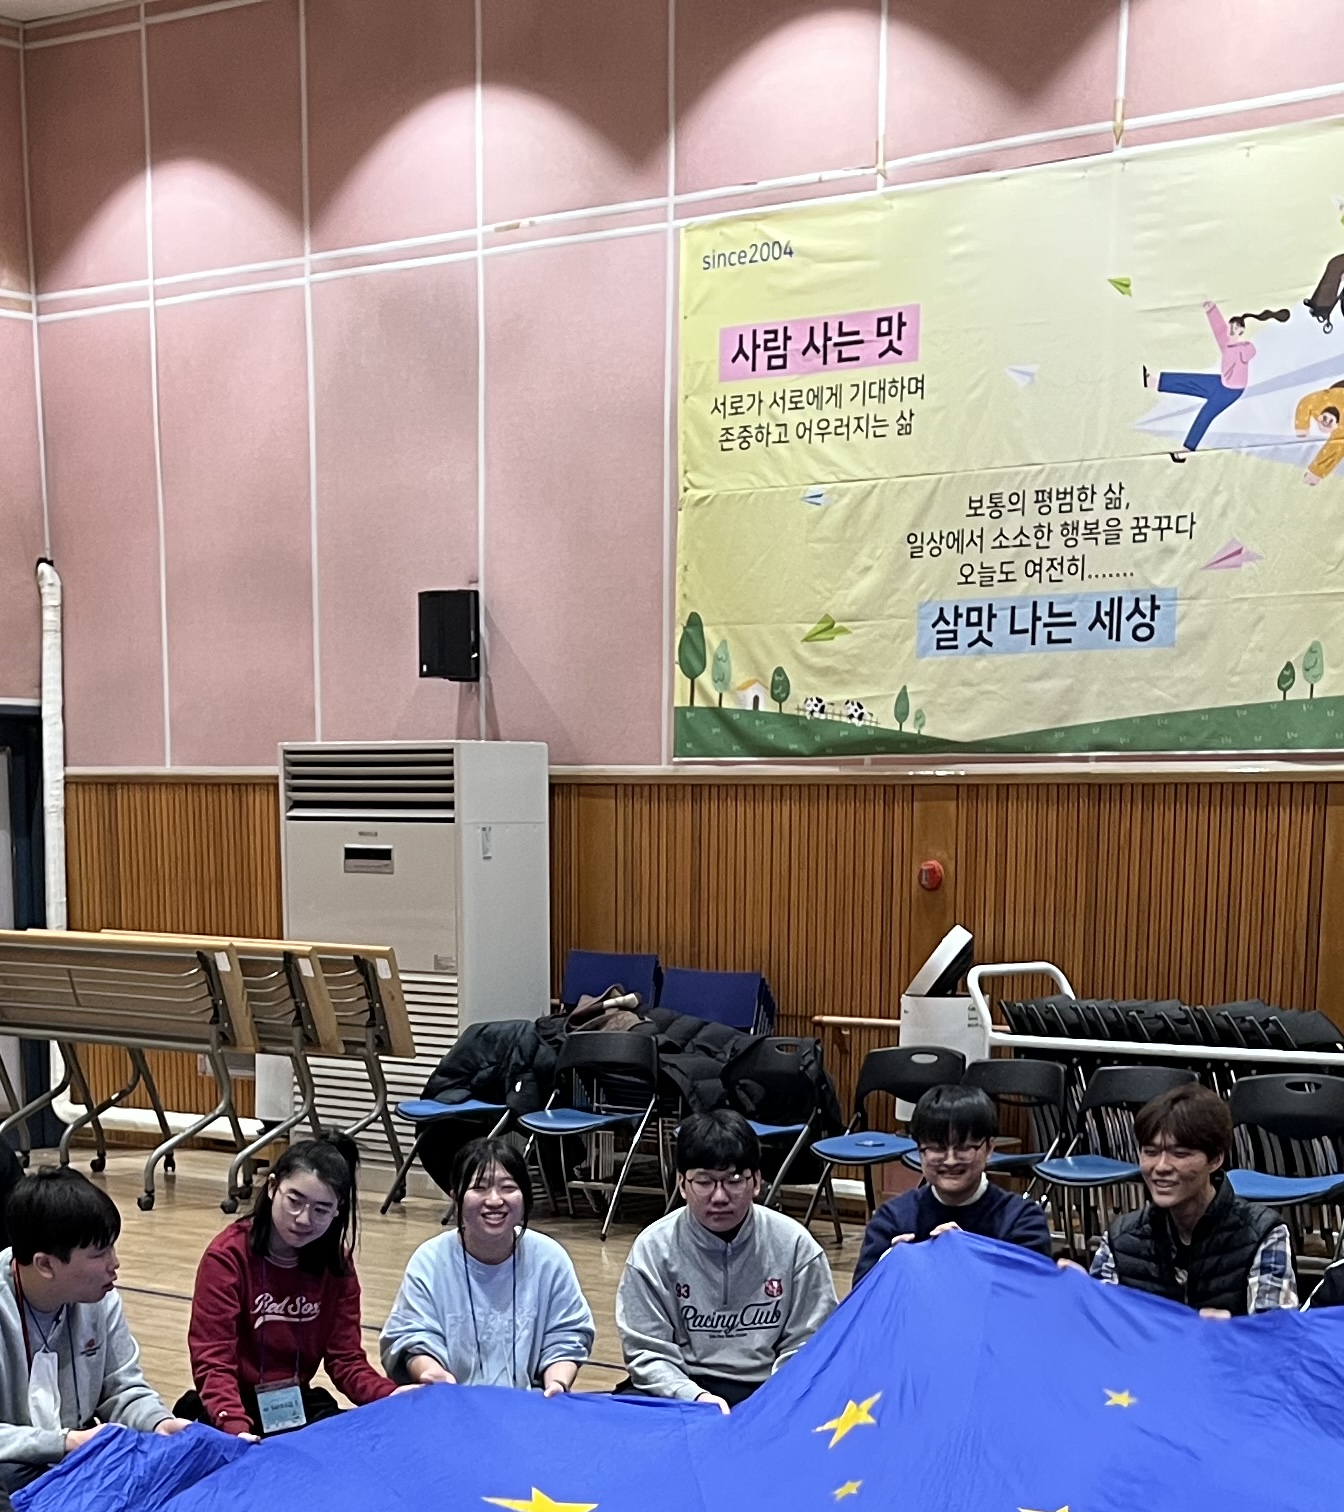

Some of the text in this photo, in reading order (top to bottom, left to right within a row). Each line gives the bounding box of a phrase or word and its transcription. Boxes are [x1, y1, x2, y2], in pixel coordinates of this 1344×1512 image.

[702, 240, 794, 270] since2004
[731, 311, 907, 372] 사람 사는 맛
[710, 374, 925, 419] 서로가 서로에게 기대하며
[718, 408, 915, 451] 존중하고 어우러지는 삶
[966, 489, 1027, 520] 보통의
[1033, 483, 1097, 515] 평범한
[906, 511, 1197, 558] 일상에서 소소한 행복을 꿈꾸다
[956, 560, 1018, 587] 오늘도
[931, 594, 1161, 650] 살맛 나는 세상
[250, 1292, 290, 1314] Red
[740, 1300, 782, 1327] Club
